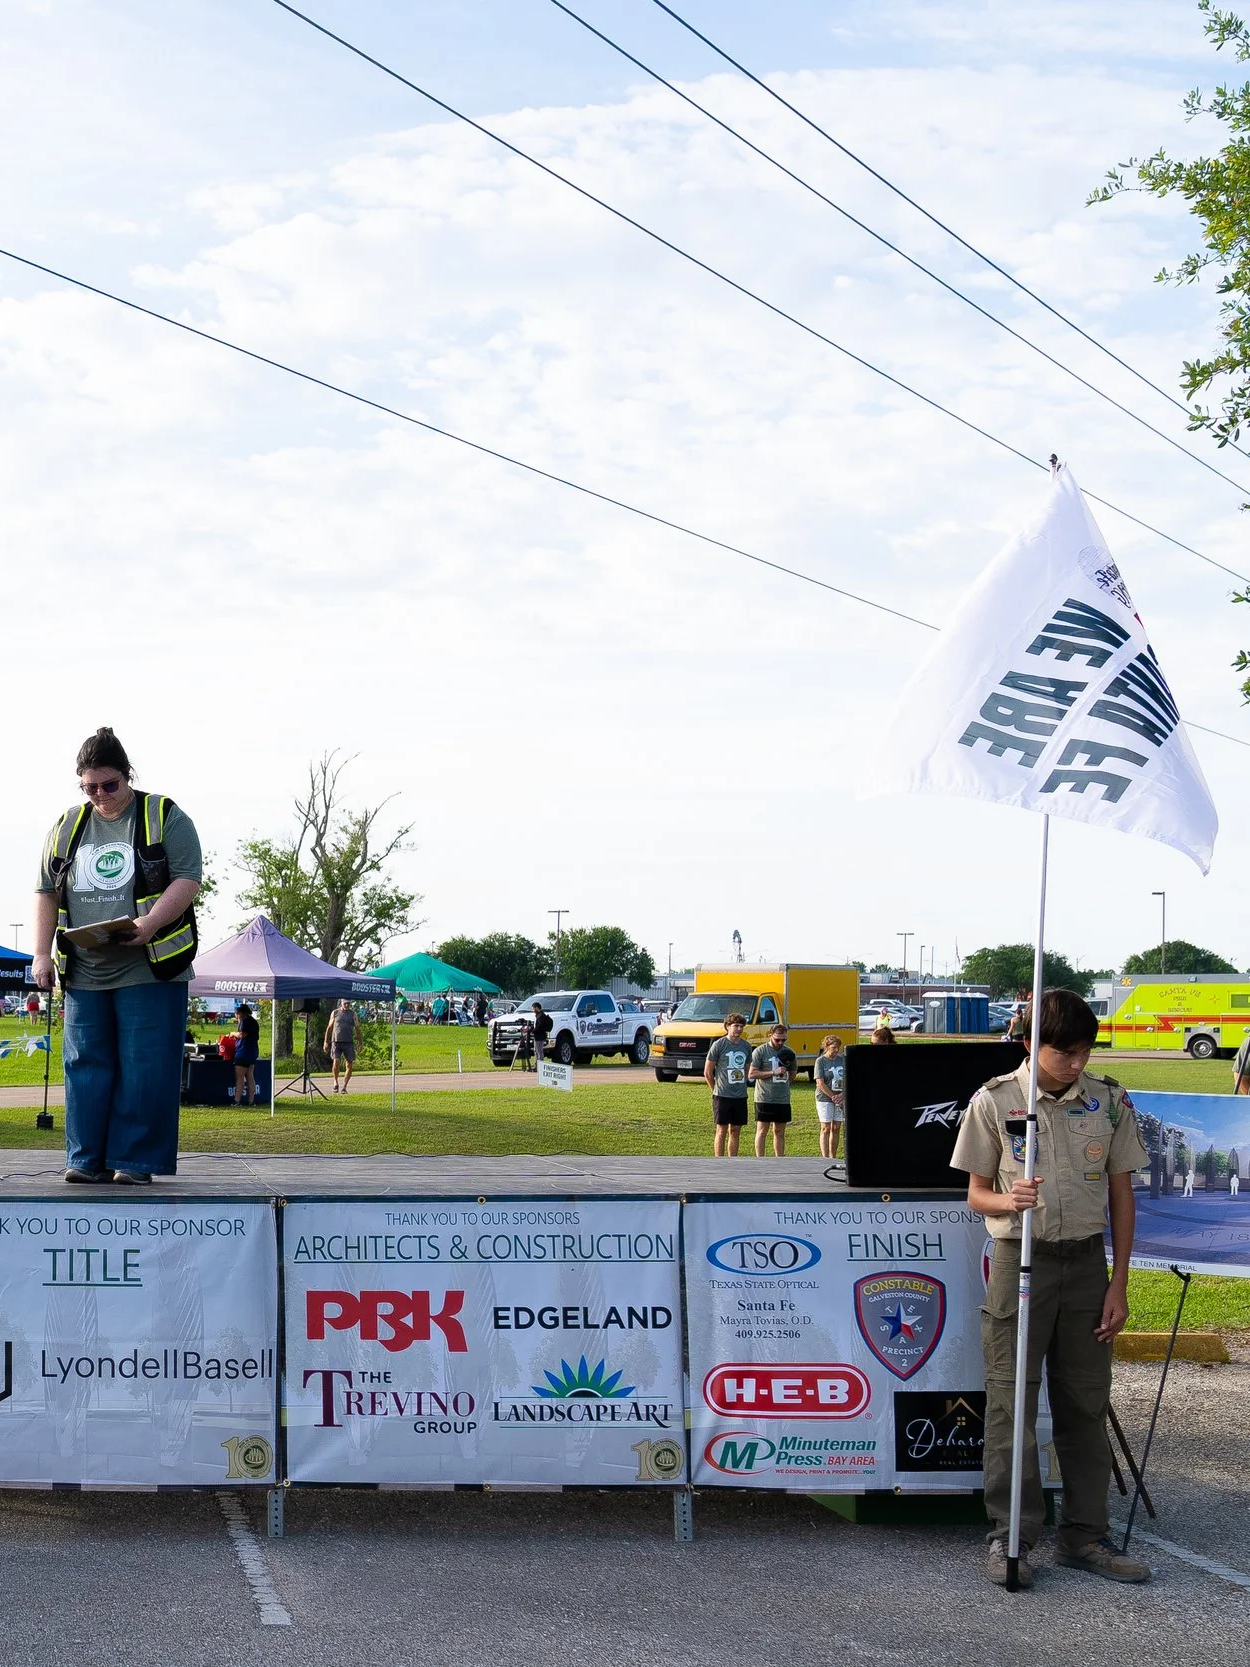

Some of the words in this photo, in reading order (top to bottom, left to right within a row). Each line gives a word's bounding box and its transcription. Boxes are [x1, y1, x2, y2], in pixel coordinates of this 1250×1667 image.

[214, 980, 254, 993] BOOSTER
[543, 1064, 567, 1074] FINISHERS
[385, 1211, 429, 1226] THANK
[431, 1211, 458, 1226] YOU
[461, 1211, 479, 1226] TO
[481, 1211, 511, 1226] OUR
[512, 1211, 580, 1226] SPONSORS
[774, 1211, 828, 1226] THANK
[831, 1211, 863, 1225] YOU
[867, 1211, 888, 1225] TO
[892, 1210, 926, 1225] OUR
[930, 1210, 985, 1225] SPONS
[16, 1217, 59, 1236] YOU
[64, 1217, 91, 1236] TO
[97, 1218, 142, 1236] OUR
[147, 1218, 246, 1237] SPONSOR
[294, 1234, 440, 1261] ARCHITECTS
[449, 1234, 469, 1260] &
[476, 1233, 675, 1261] CONSTRUCTION
[848, 1232, 944, 1259] FINISH
[731, 1240, 800, 1270] TSO
[43, 1248, 142, 1283] TITLE
[709, 1279, 743, 1290] TEXAS
[744, 1279, 776, 1290] STATE
[777, 1279, 820, 1290] OPTICAL
[863, 1279, 935, 1296] CONSTABLE
[868, 1292, 904, 1303] GALVESTON
[904, 1292, 931, 1303] COUNTY
[737, 1299, 776, 1312] Santa
[779, 1300, 796, 1312] Fe
[306, 1290, 468, 1353] PBK
[493, 1306, 673, 1330] EDGELAND
[719, 1315, 752, 1327] Mayra
[755, 1315, 789, 1327] Tovias,
[791, 1315, 815, 1326] O.D.
[734, 1329, 801, 1340] 409.925.2506
[881, 1346, 924, 1356] PRECINCT
[41, 1348, 273, 1384] LyondellBasell
[901, 1358, 908, 1367] 2
[359, 1371, 392, 1384] THE
[723, 1378, 850, 1405] H-E-B
[492, 1400, 622, 1422] LANDSCAPE
[413, 1420, 478, 1434] GROUP
[779, 1436, 877, 1451] Minuteman
[775, 1451, 823, 1466] Press
[827, 1456, 848, 1466] BAY
[849, 1456, 876, 1466] AREA
